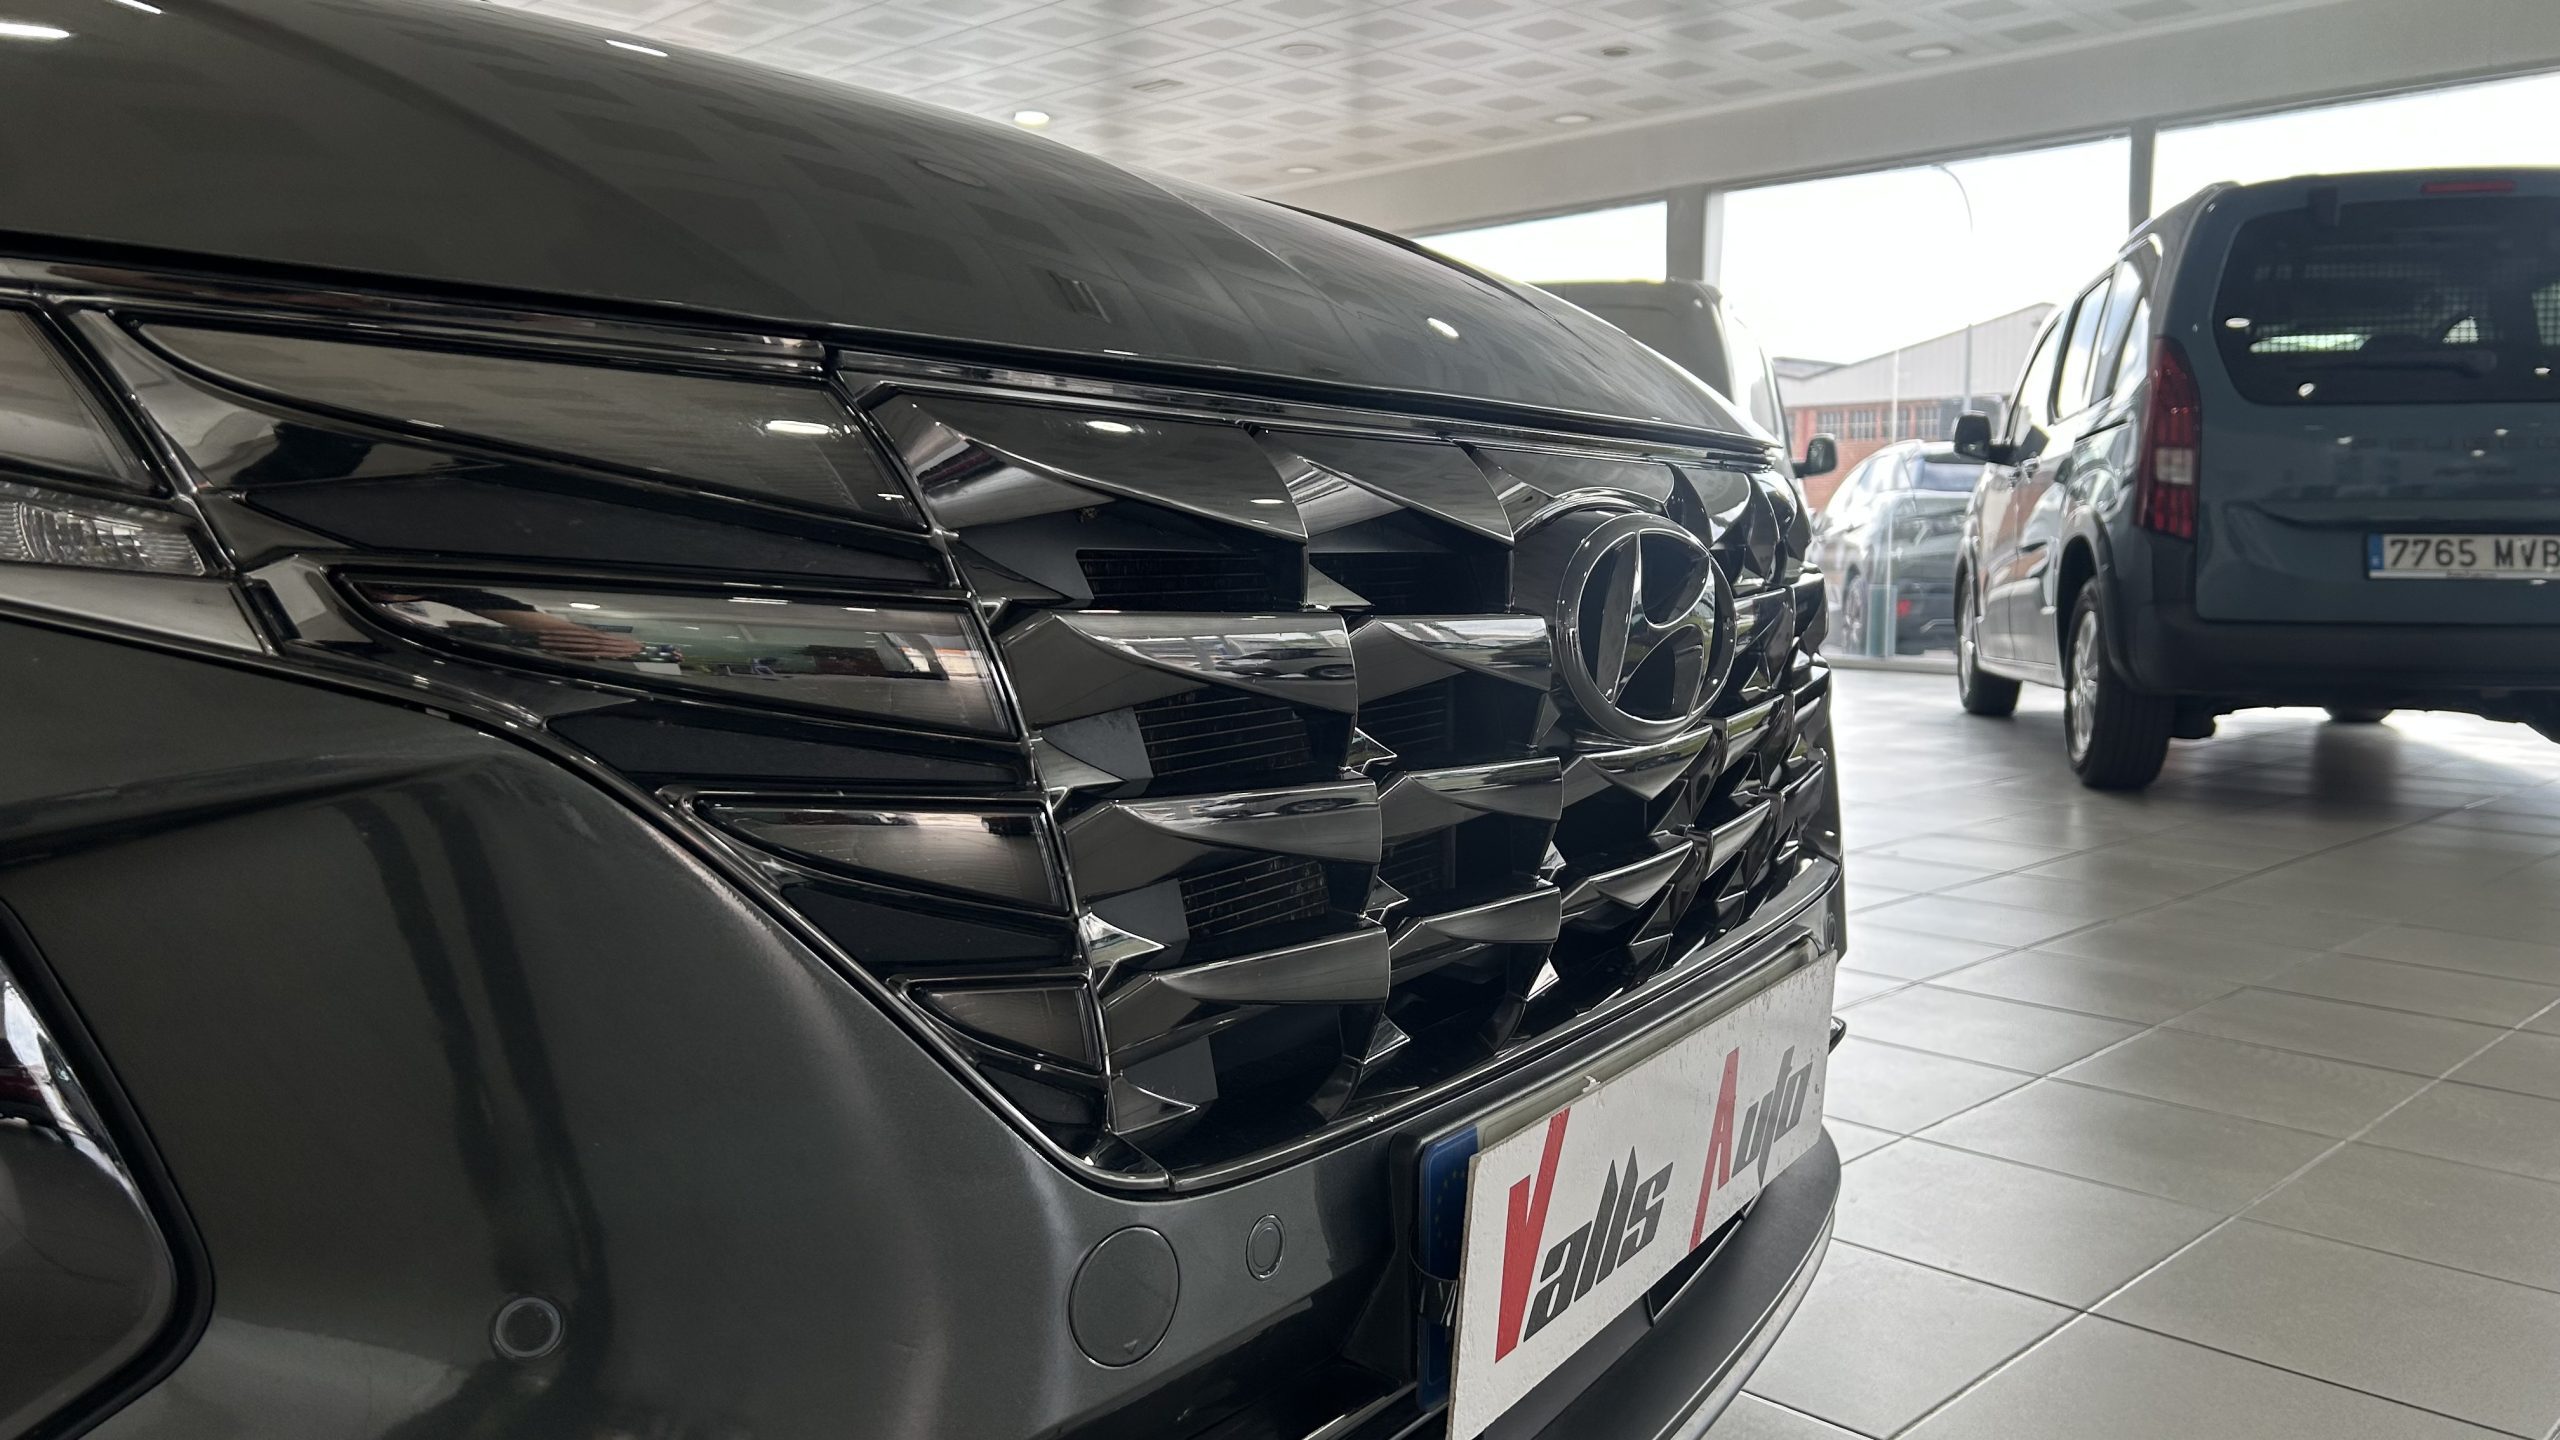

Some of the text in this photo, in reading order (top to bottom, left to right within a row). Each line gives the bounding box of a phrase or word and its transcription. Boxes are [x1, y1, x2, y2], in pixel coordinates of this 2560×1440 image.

[2389, 538, 2560, 568] 7765 MVB
[1495, 1045, 1813, 1363] Valls Auto
